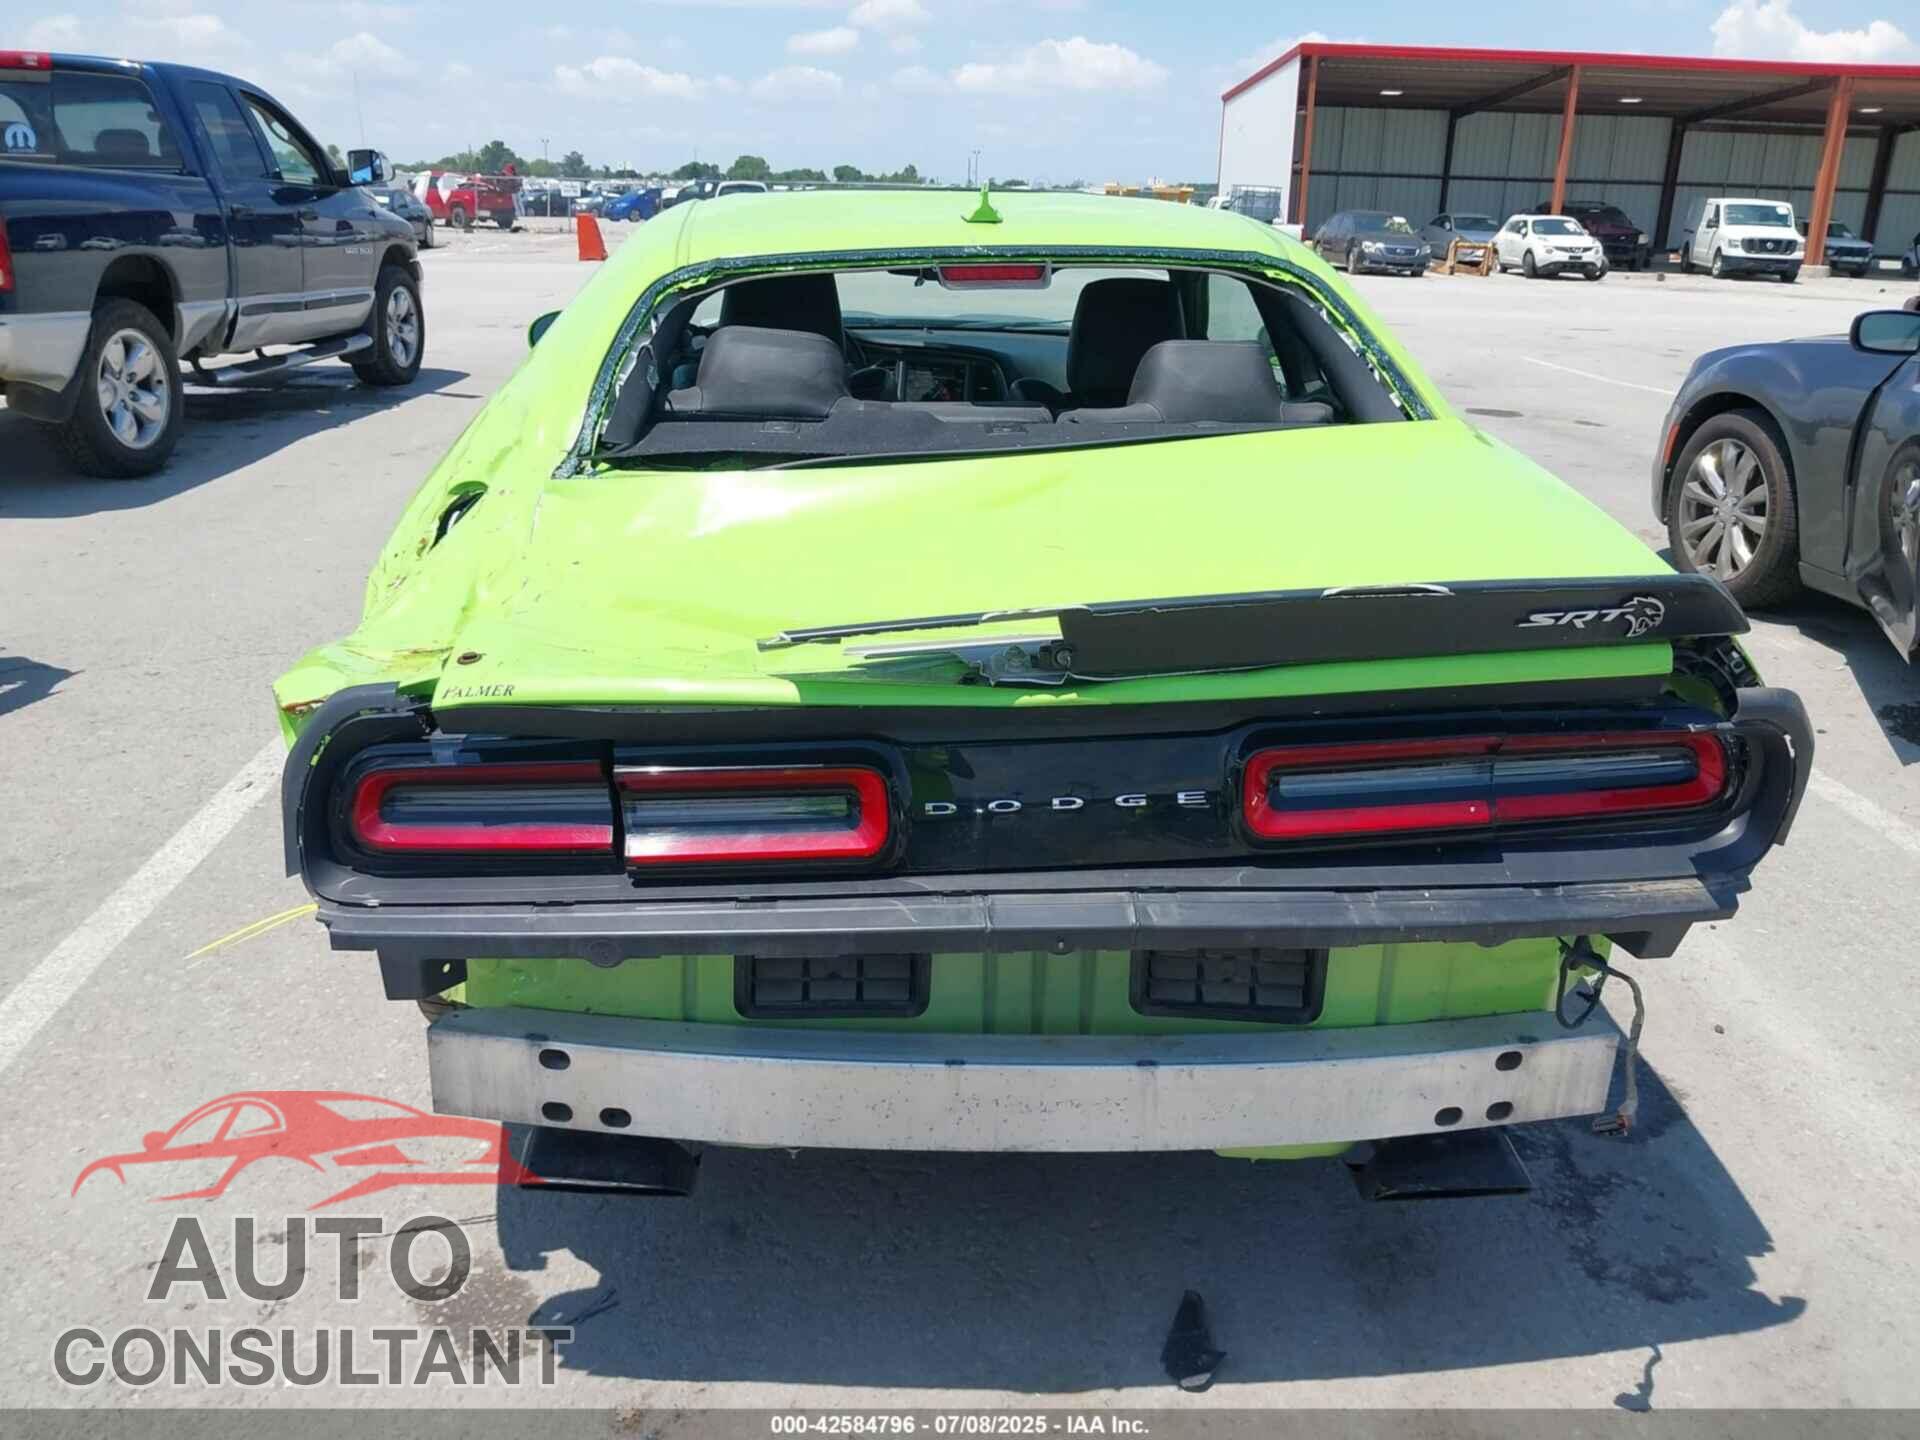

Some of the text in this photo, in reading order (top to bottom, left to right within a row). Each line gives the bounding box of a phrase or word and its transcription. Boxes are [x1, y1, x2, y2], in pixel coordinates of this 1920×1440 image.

[1517, 607, 1635, 629] SRT
[441, 684, 516, 700] PALMER
[924, 791, 1210, 816] DODGE
